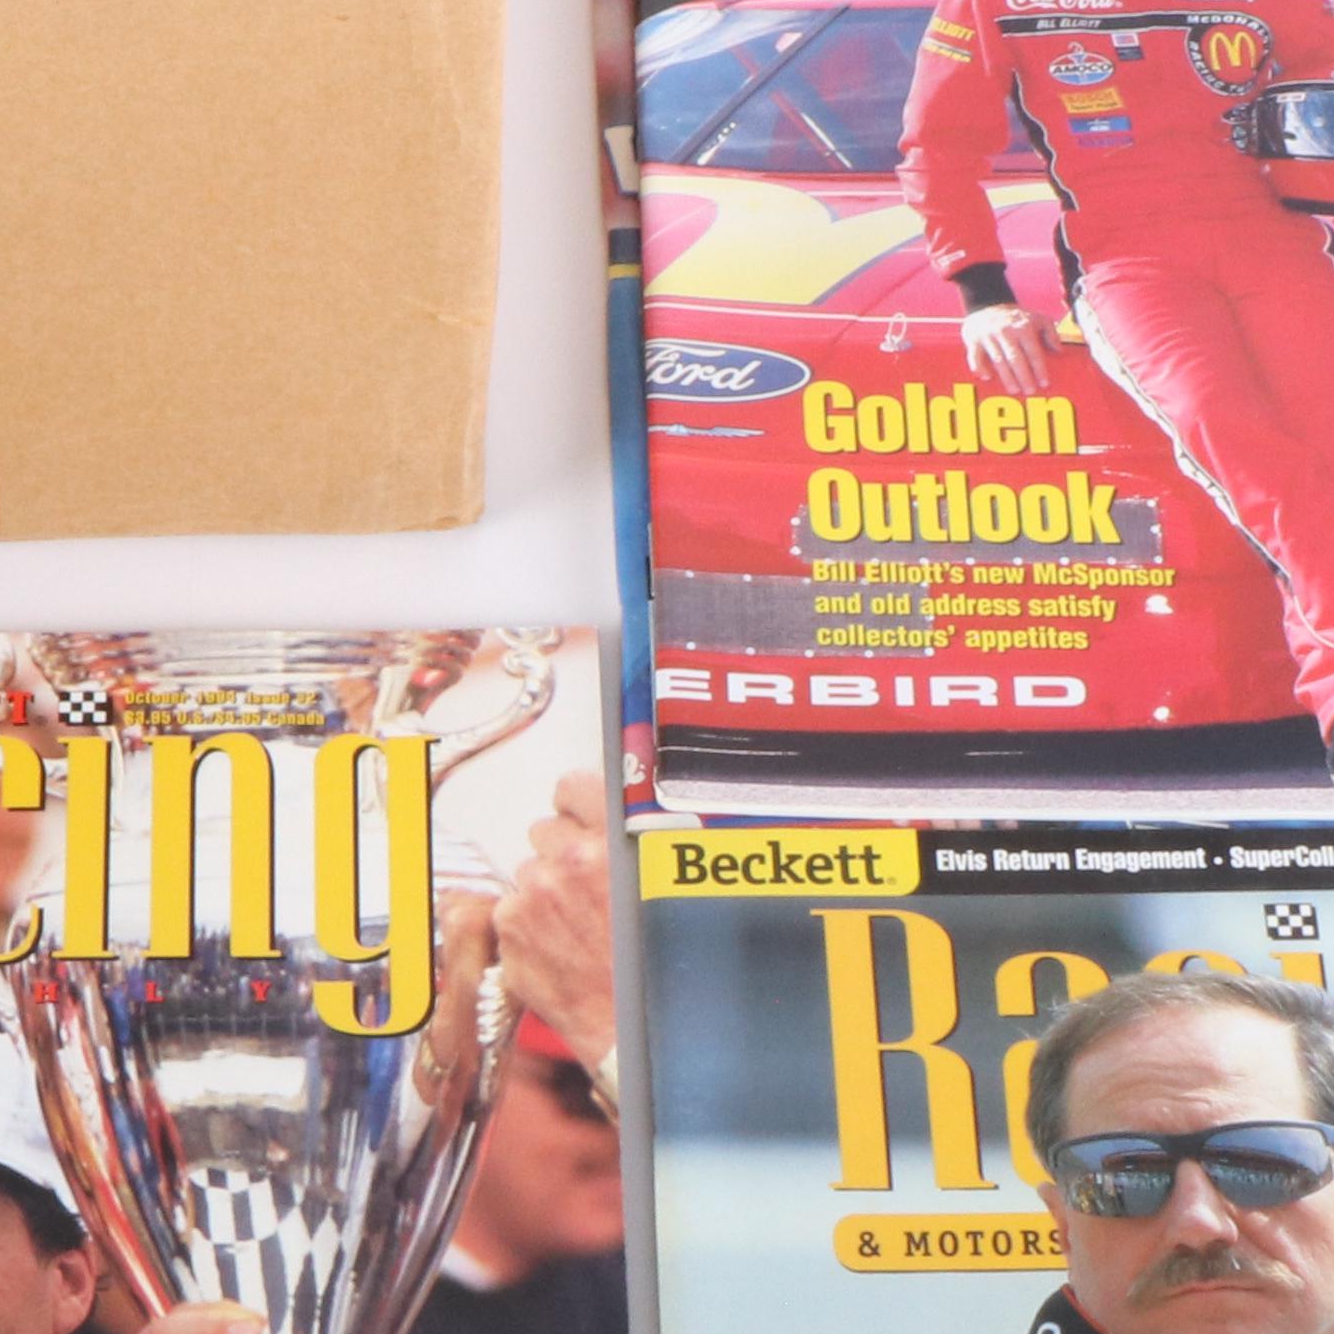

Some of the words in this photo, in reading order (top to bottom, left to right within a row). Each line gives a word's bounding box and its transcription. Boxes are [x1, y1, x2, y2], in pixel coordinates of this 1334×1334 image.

[803, 381, 1077, 454] Golden
[807, 468, 1121, 544] Outlook
[812, 561, 856, 584] Bill
[864, 561, 965, 585] Elliott's
[972, 568, 1025, 585] new
[1033, 564, 1175, 589] McSponsor
[814, 593, 862, 614] and
[870, 593, 912, 616] old
[920, 595, 1022, 617] address
[1028, 595, 1116, 622] satisfy
[817, 624, 956, 649] collectors'
[965, 626, 1089, 653] appetites
[125, 691, 189, 704] October
[655, 667, 1087, 707] ERBIRD
[266, 710, 325, 725] Canada
[671, 841, 883, 886] Beckett
[936, 849, 988, 871] Elvis
[993, 849, 1070, 871] Return
[1075, 847, 1207, 873] Engagement
[858, 1230, 881, 1257] &
